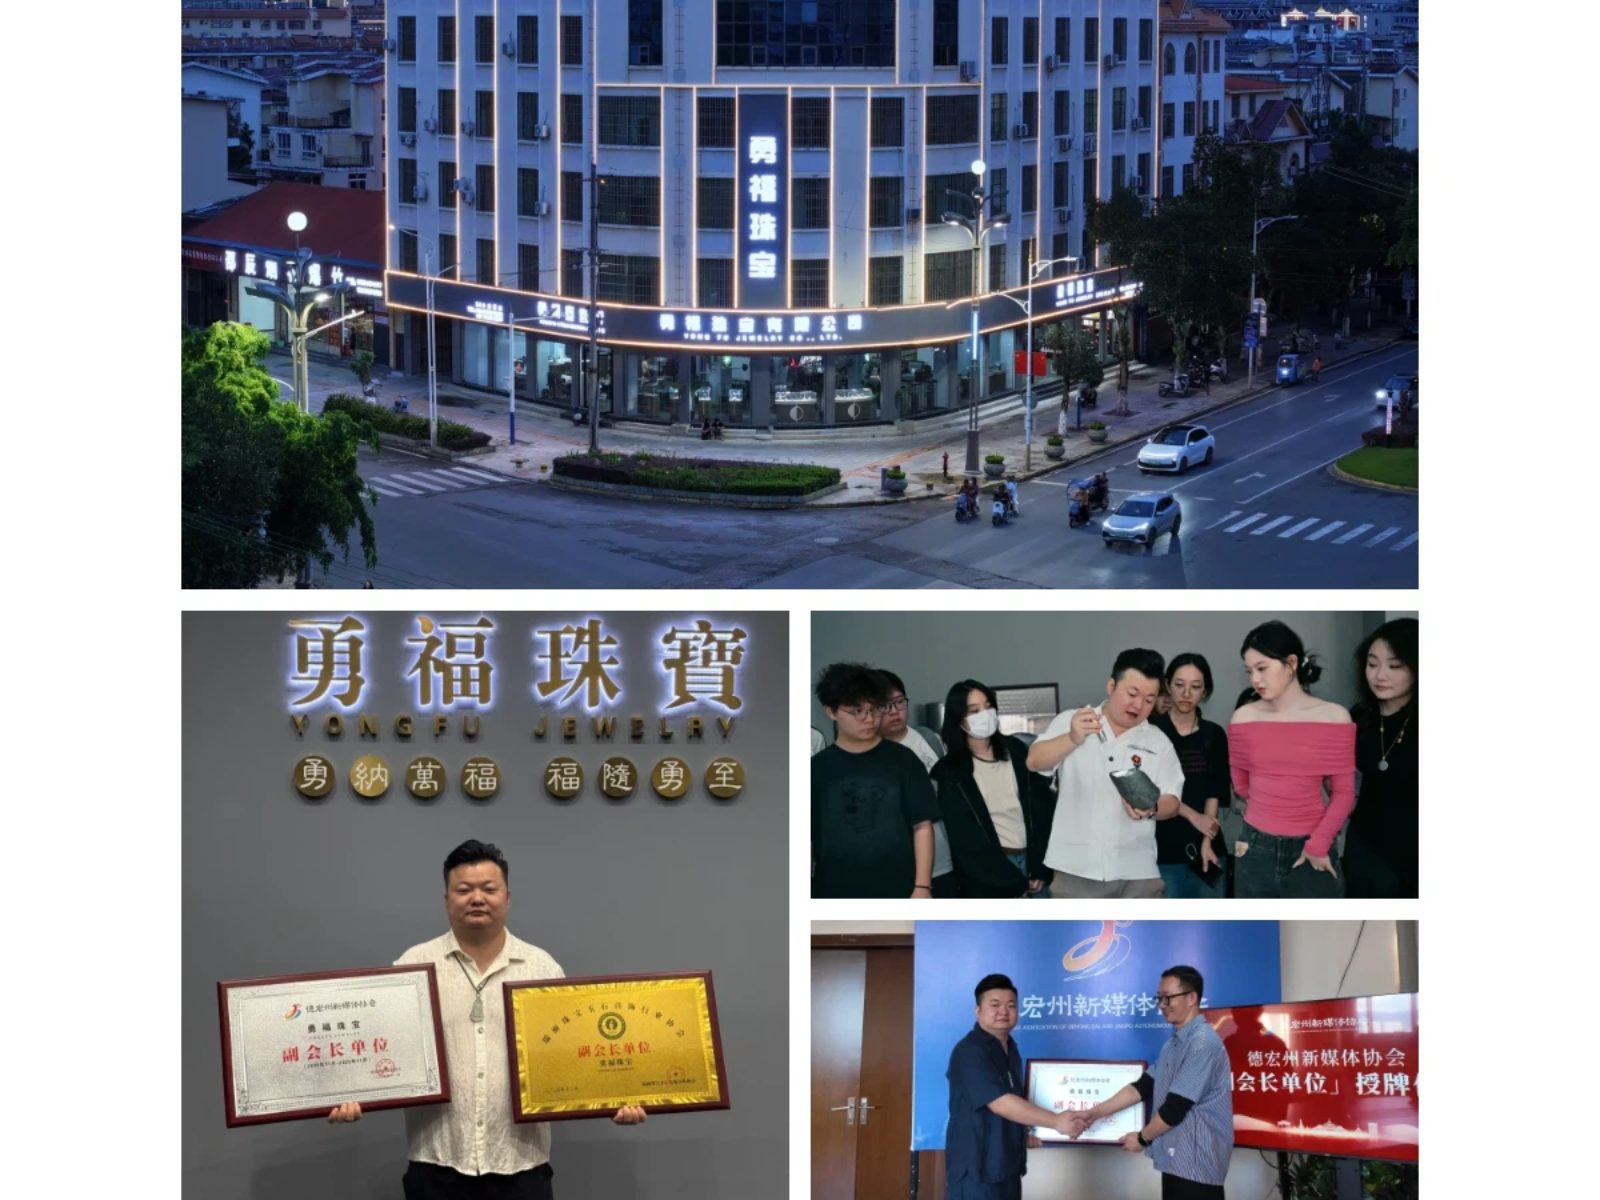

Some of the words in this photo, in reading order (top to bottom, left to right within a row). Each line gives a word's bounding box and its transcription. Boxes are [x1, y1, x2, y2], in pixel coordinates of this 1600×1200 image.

[288, 616, 748, 711] 勇福珠寶
[289, 714, 484, 738] YONGFU
[533, 714, 738, 738] JEWELRY
[301, 758, 498, 792] 勇納萬福
[547, 758, 744, 792] 福隨勇至
[282, 1037, 389, 1064] 副会长单位
[578, 1041, 652, 1058] 副会长单位
[1247, 1047, 1406, 1069] 德宏州新媒体协会
